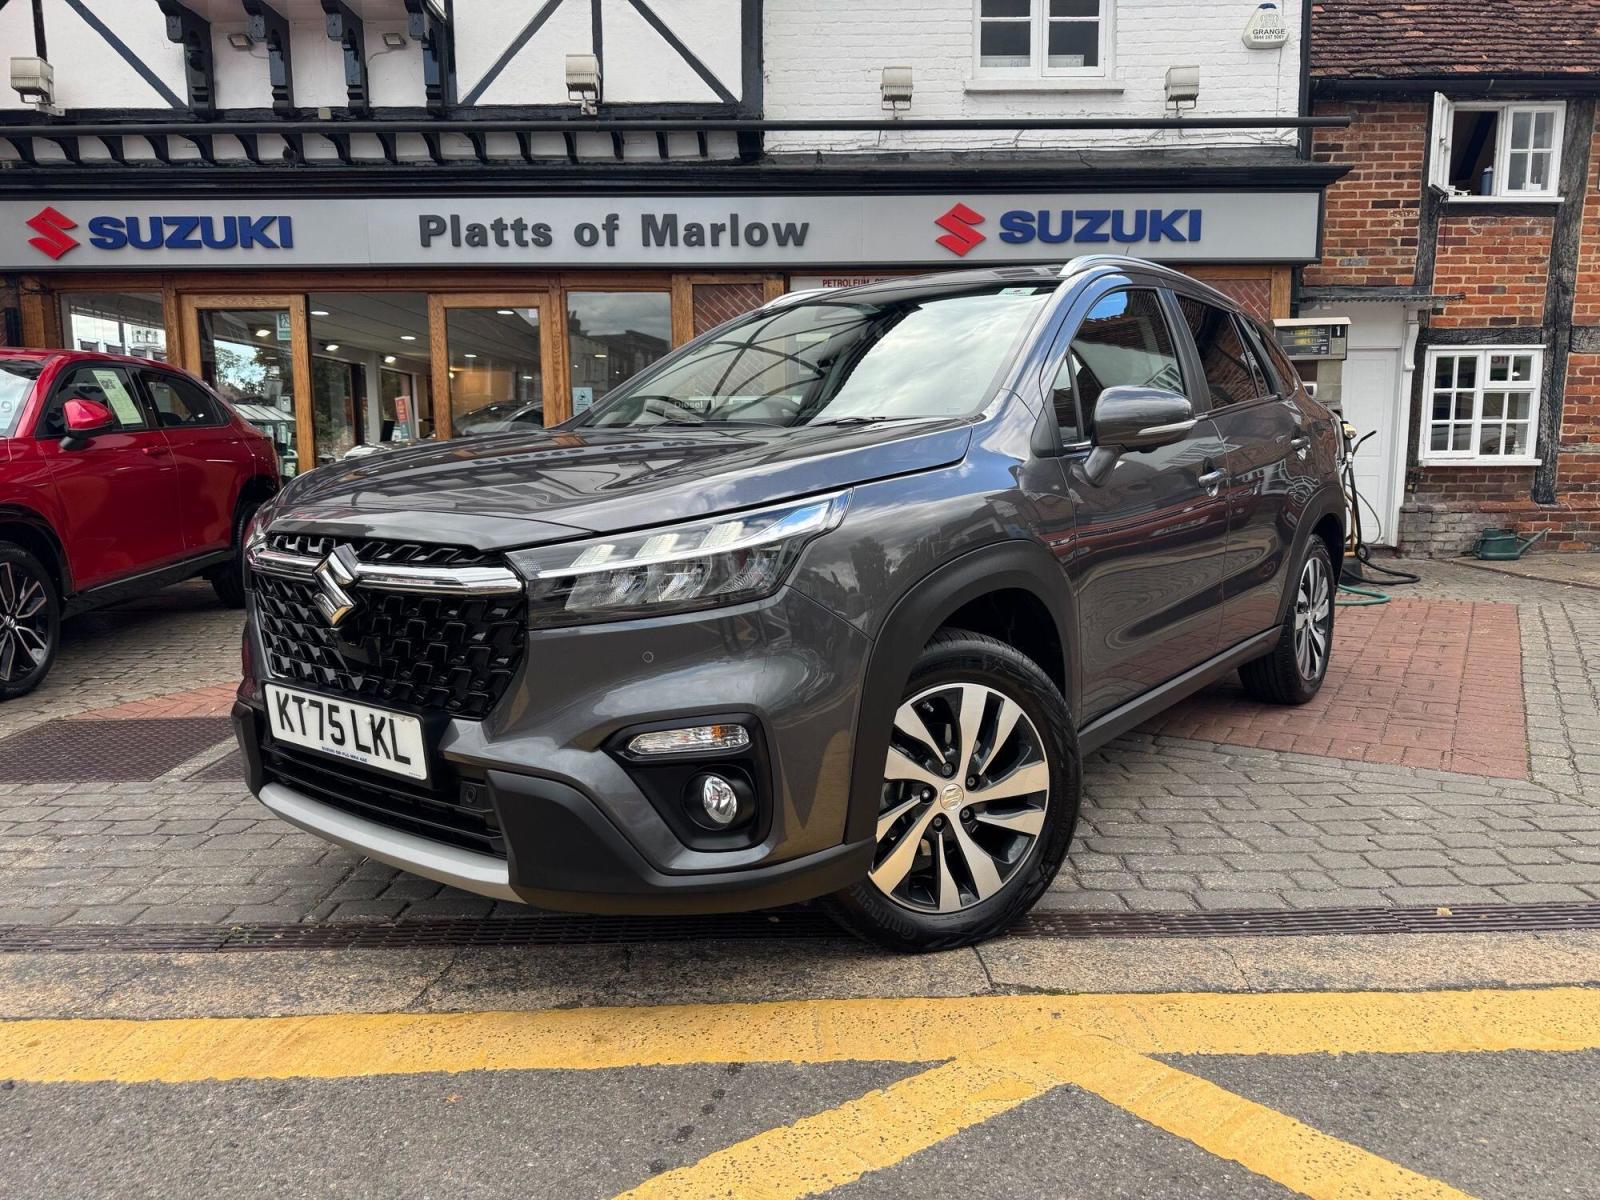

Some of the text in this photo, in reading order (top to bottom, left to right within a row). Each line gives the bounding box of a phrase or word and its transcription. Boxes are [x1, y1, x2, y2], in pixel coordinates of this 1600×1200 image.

[88, 216, 294, 250] SUZUKI
[418, 212, 811, 248] Platts of Marlow
[998, 208, 1203, 243] SUZUKI
[1336, 326, 1340, 336] 1
[275, 690, 411, 766] KT75 LKL
